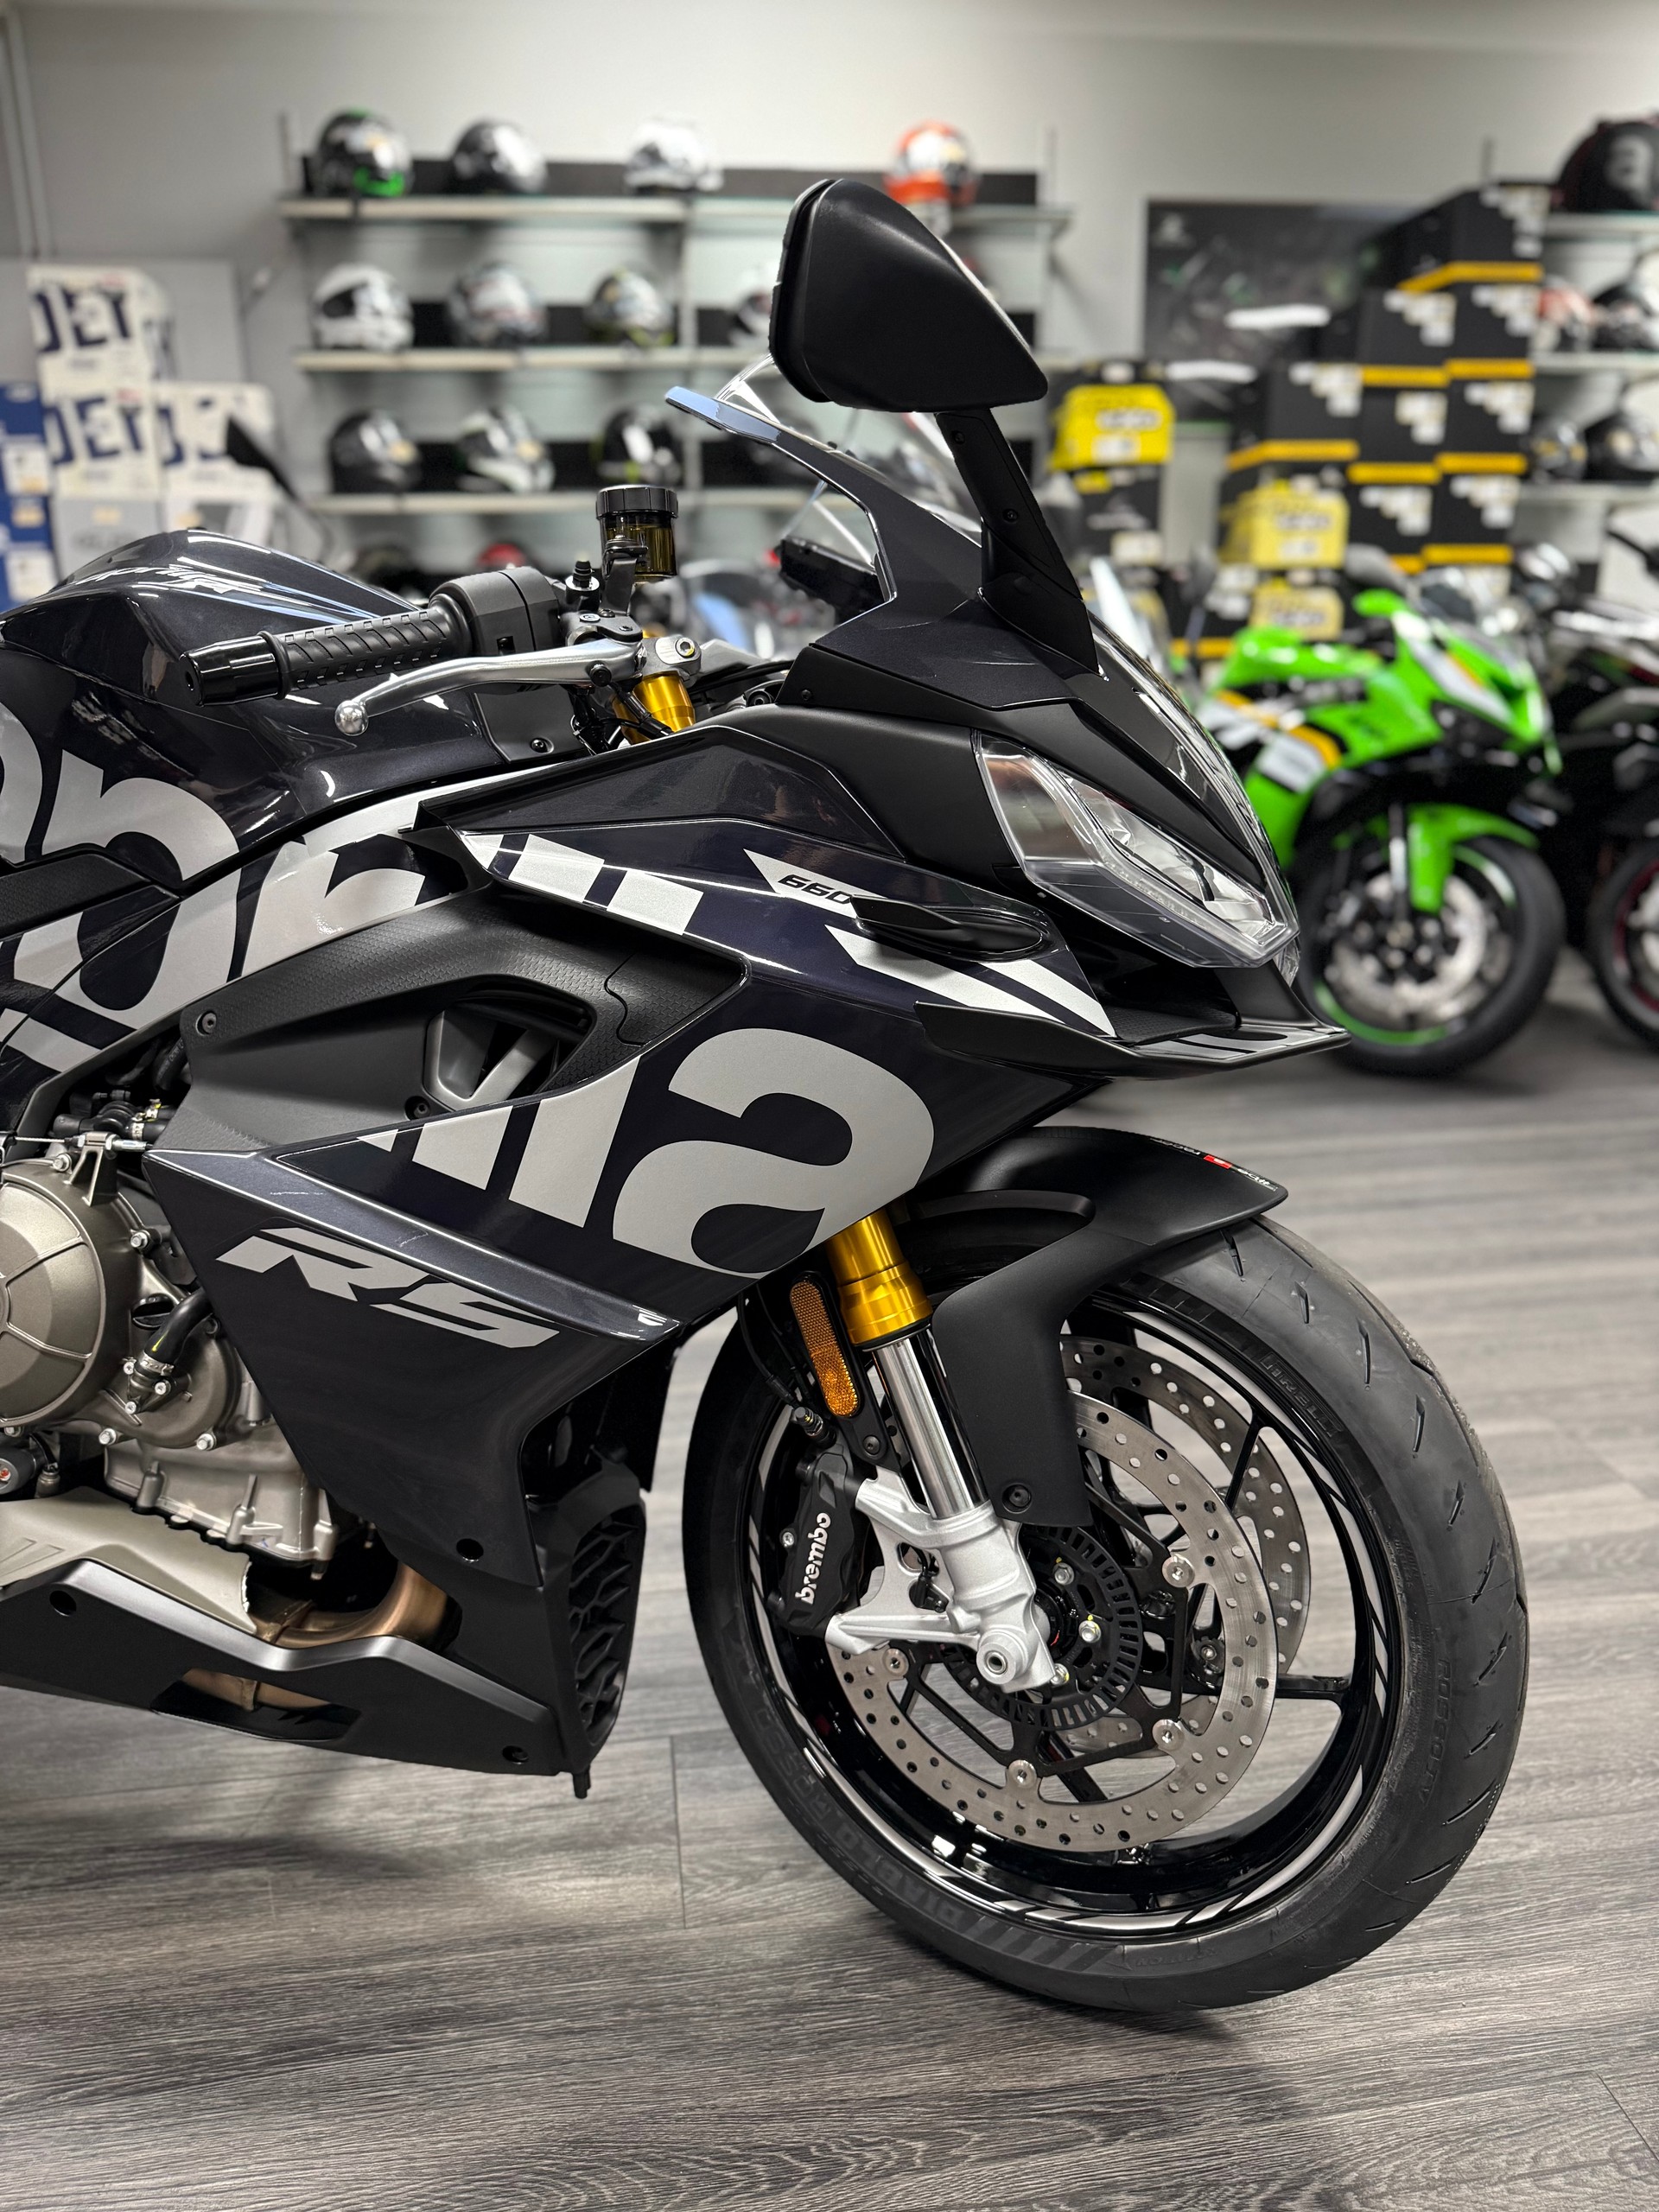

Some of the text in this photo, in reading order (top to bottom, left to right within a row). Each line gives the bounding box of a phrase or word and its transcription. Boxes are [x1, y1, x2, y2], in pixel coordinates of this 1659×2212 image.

[778, 874, 853, 905] 660
[215, 1226, 561, 1349] RS
[795, 1512, 831, 1605] brembo
